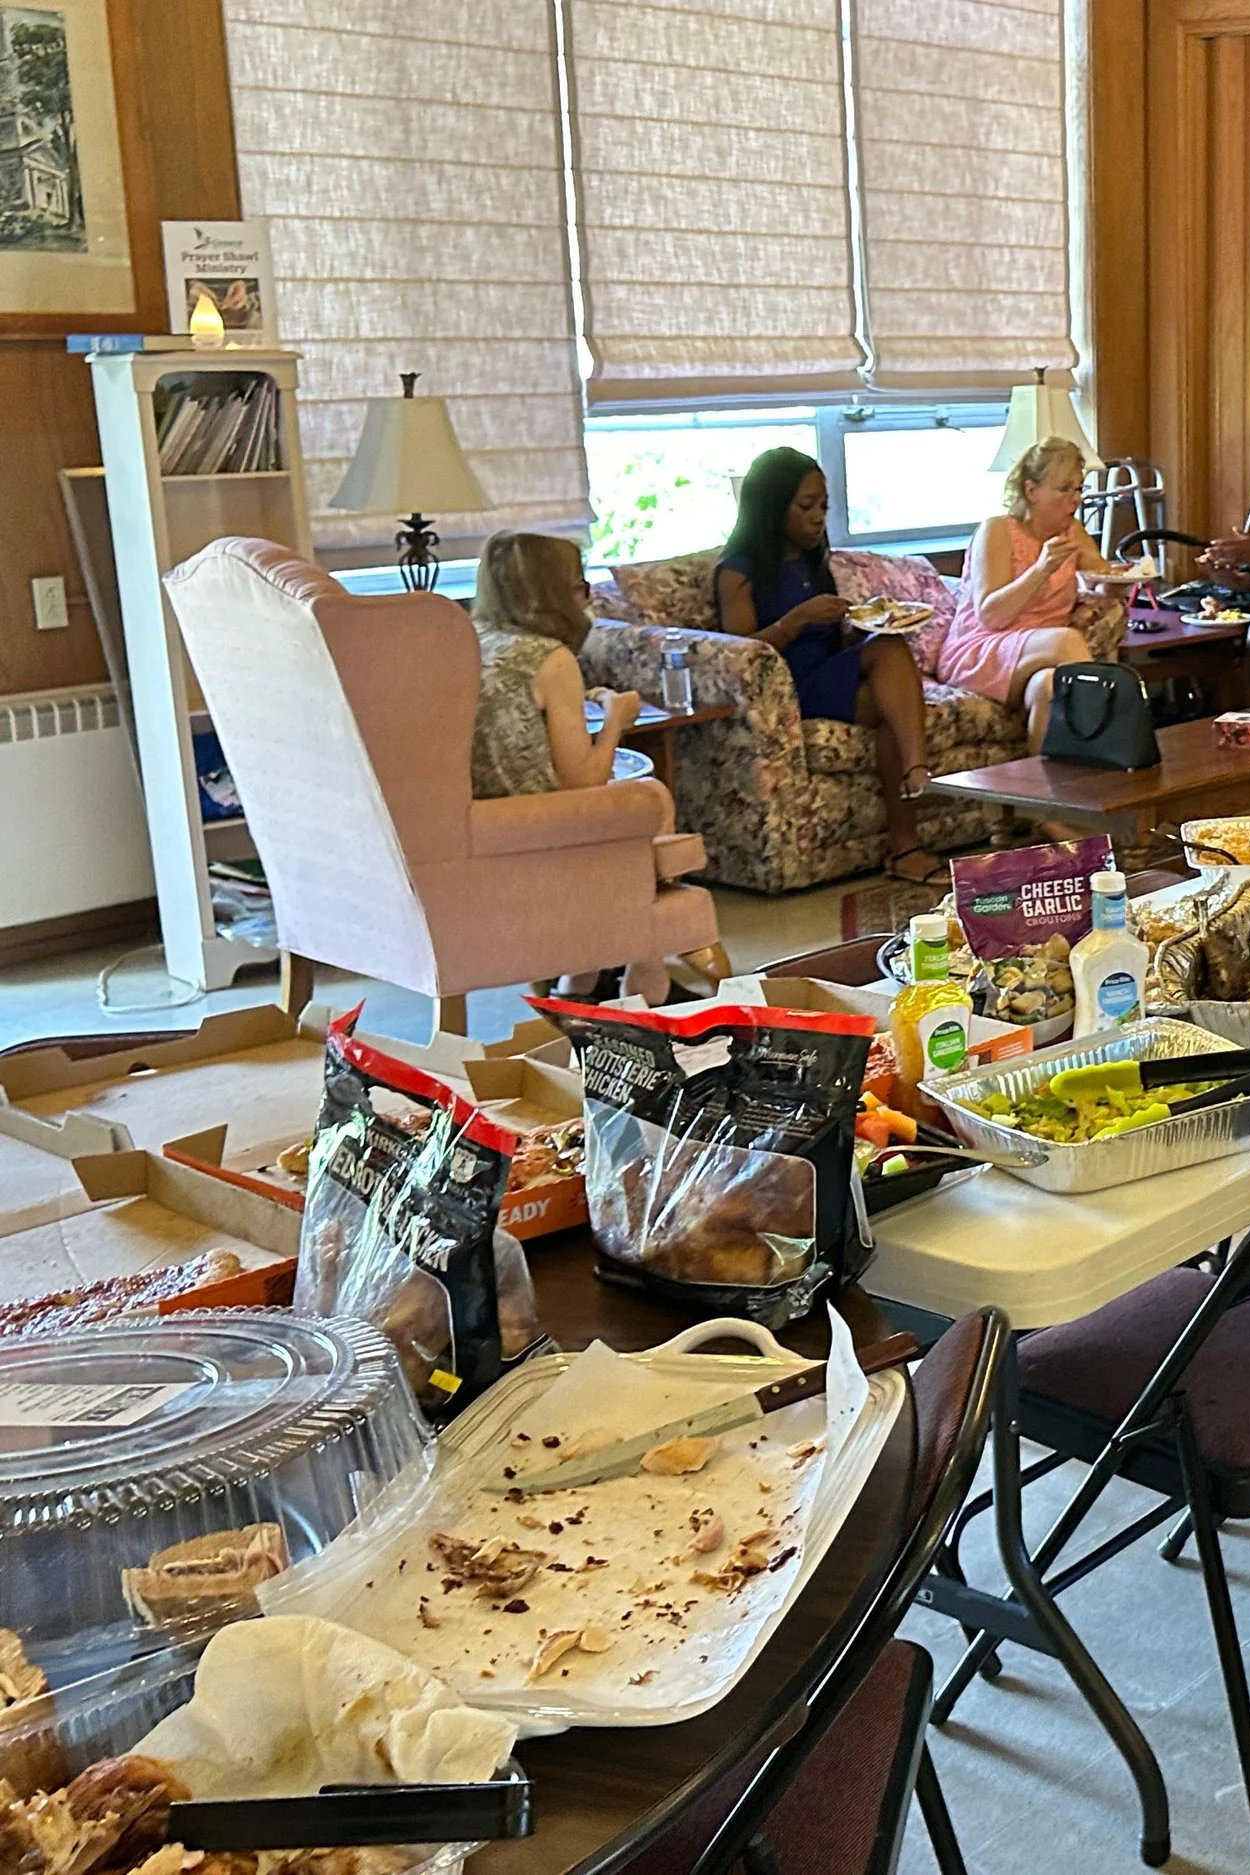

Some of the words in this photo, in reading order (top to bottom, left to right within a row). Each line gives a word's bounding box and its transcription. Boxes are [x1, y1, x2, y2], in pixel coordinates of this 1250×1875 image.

[181, 252, 221, 263] Prayer
[223, 251, 259, 261] Shawl
[195, 264, 247, 274] Ministry
[1021, 876, 1085, 900] CHEESE
[974, 894, 1008, 906] Tuscan
[1022, 894, 1083, 918] GARLIC
[973, 902, 1012, 914] Garden
[1025, 914, 1082, 927] CROUTONS
[585, 1045, 660, 1092] ROTISERIE
[497, 1196, 553, 1228] EADY
